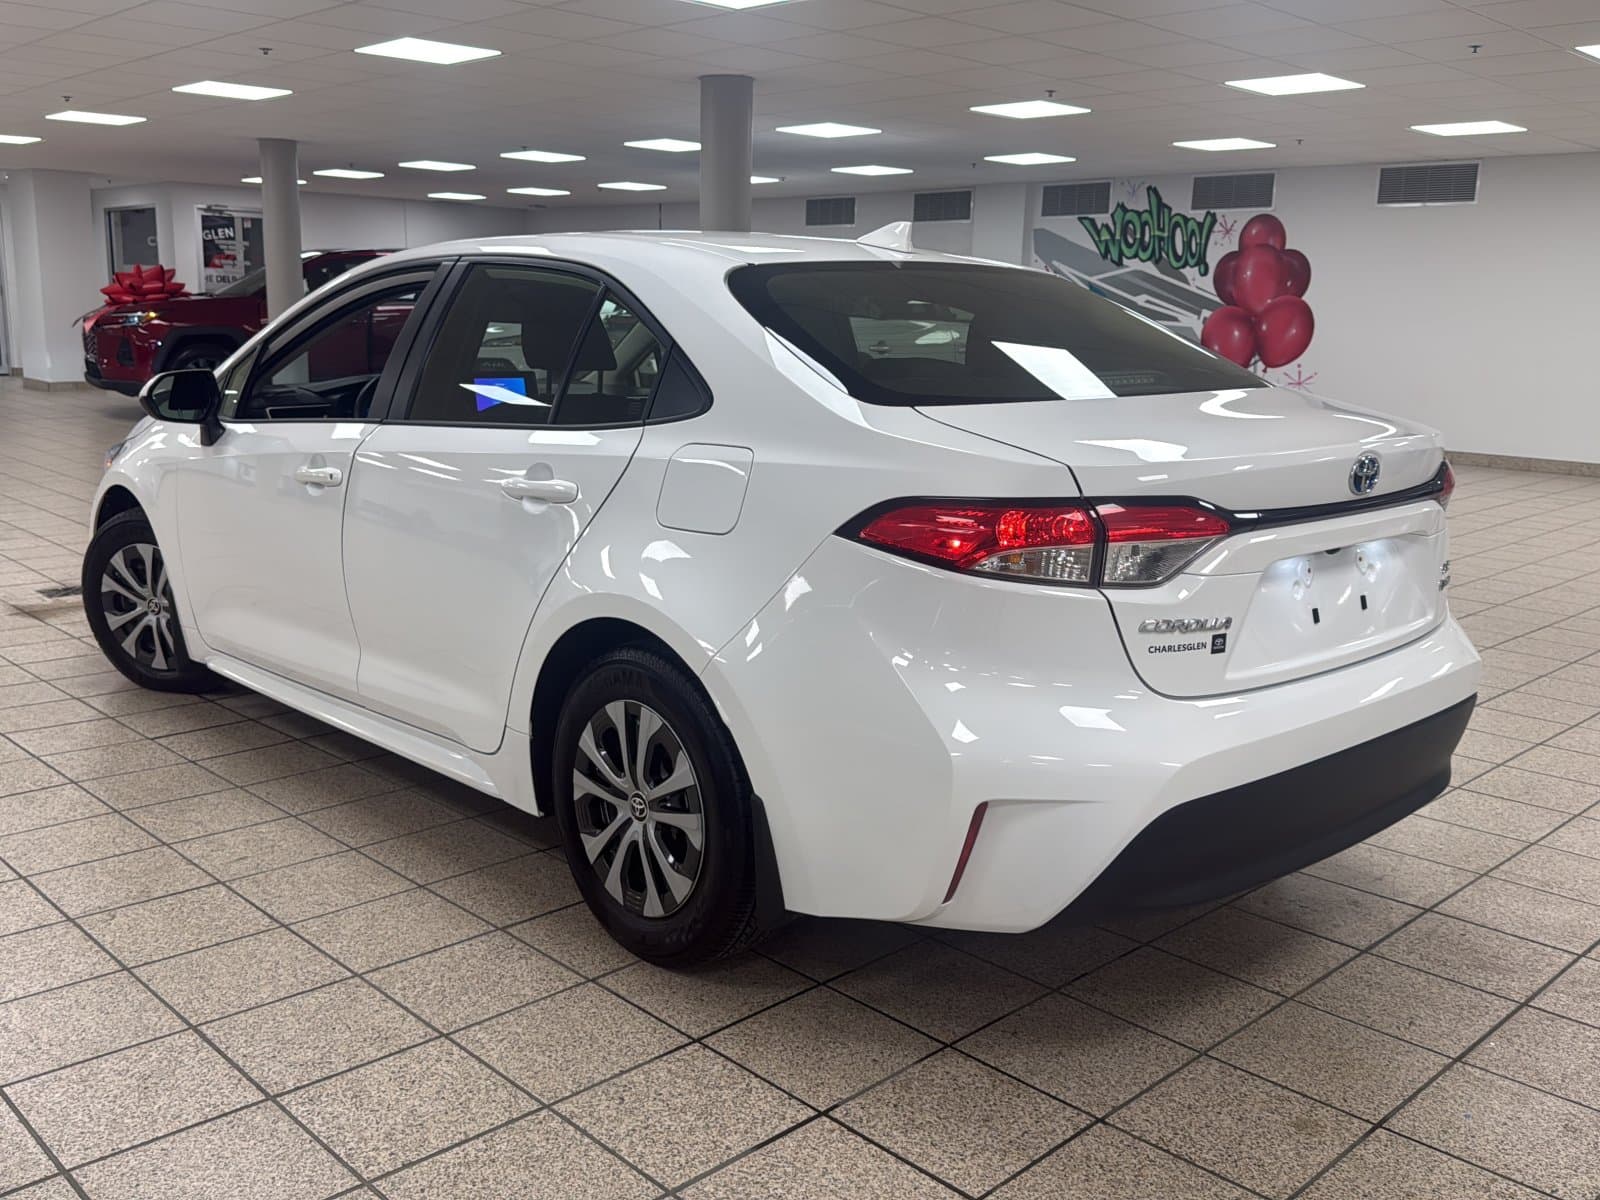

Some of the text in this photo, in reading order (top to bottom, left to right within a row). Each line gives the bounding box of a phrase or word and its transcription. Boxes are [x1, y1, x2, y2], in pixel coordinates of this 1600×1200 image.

[203, 227, 235, 241] GLEN
[1138, 616, 1233, 634] COROLLA
[1148, 641, 1208, 654] CHARLESGLEN
